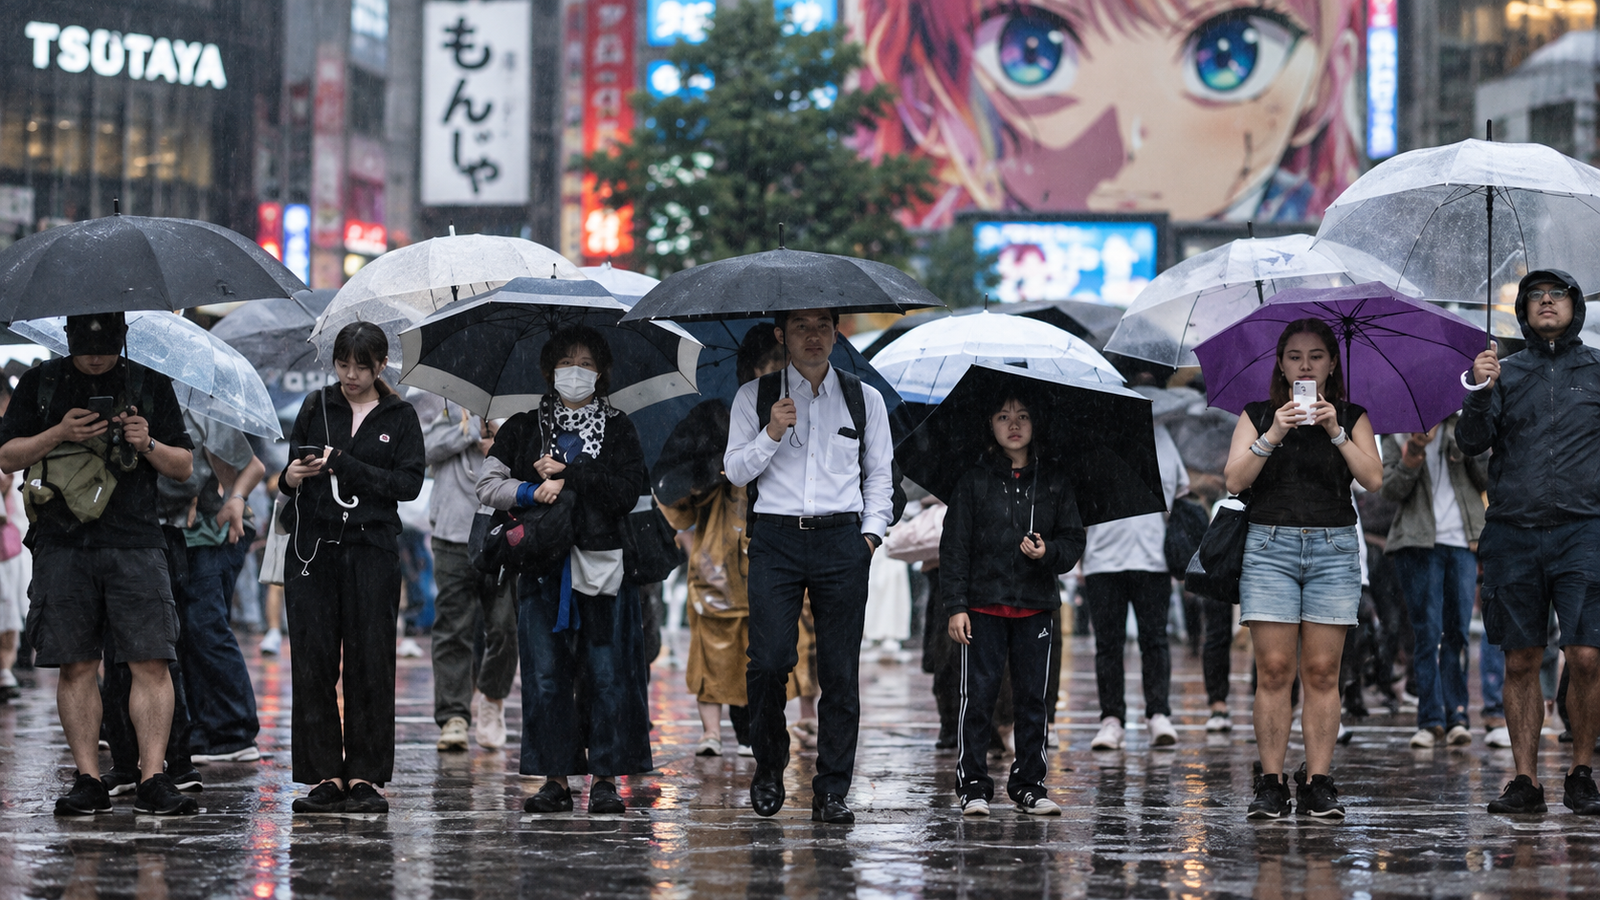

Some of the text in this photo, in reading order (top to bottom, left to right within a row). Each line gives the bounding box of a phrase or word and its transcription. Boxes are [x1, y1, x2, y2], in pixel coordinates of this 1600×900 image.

[25, 21, 227, 90] TSUTAYA
[442, 17, 500, 194] もんじゃ
